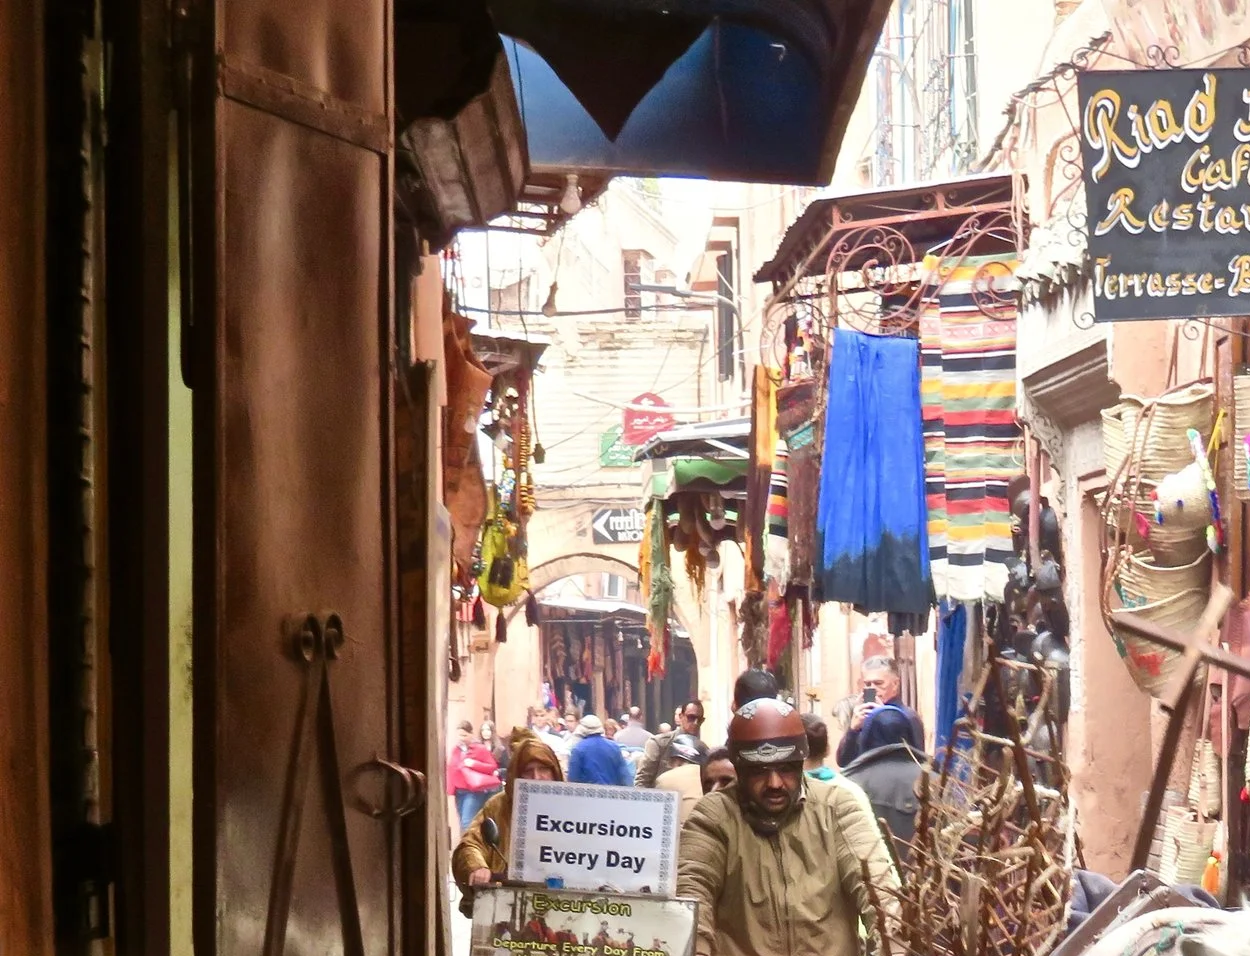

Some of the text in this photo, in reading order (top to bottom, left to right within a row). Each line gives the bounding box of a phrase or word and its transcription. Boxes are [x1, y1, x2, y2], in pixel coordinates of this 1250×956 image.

[1084, 73, 1217, 183] Riad
[536, 814, 653, 839] Excursions
[539, 846, 646, 873] Every Day
[532, 893, 632, 917] Excursion
[493, 937, 557, 951] Departure
[562, 942, 598, 956] Every
[603, 944, 628, 956] Day
